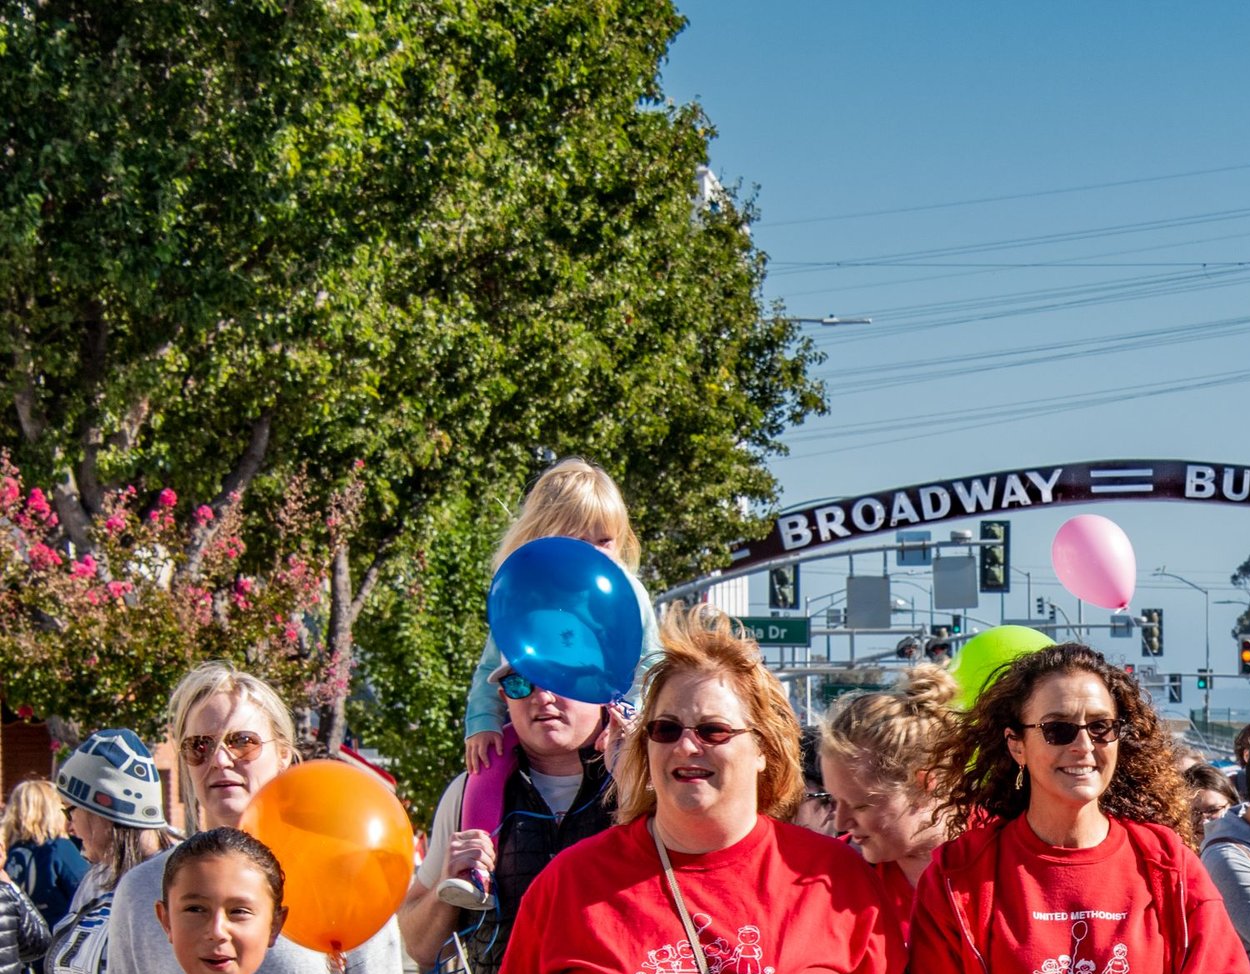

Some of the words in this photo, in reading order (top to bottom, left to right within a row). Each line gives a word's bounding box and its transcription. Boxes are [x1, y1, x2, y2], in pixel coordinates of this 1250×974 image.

[778, 469, 1063, 551] BROADWAY
[768, 625, 788, 639] Dr
[1033, 911, 1068, 920] UNITED
[1071, 911, 1128, 920] METHODIST
